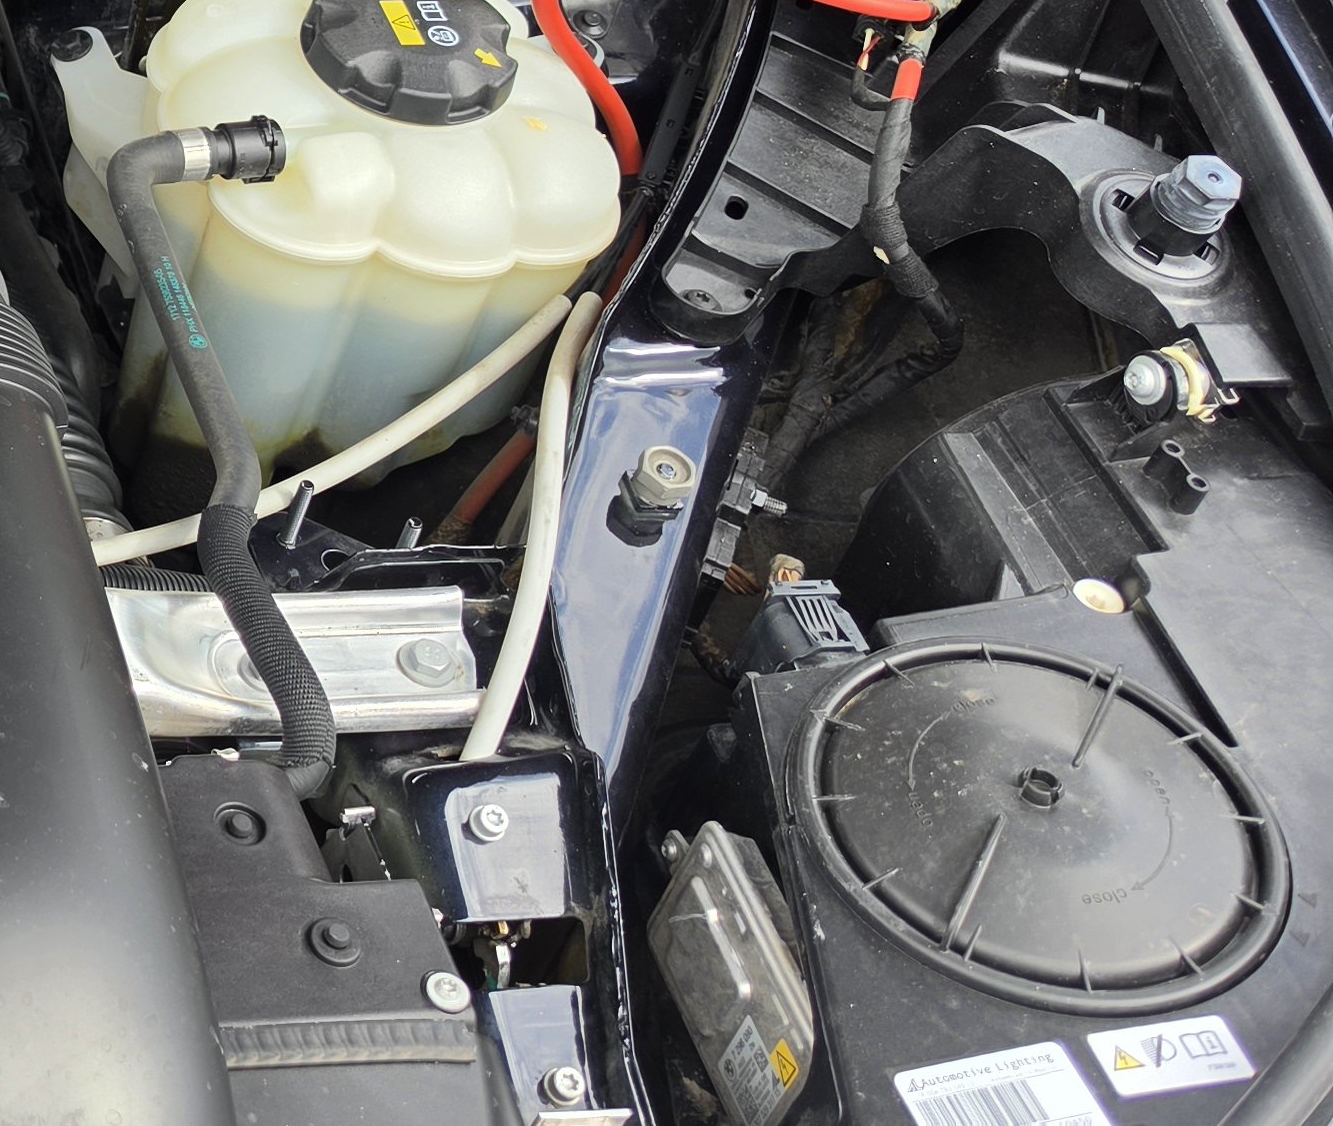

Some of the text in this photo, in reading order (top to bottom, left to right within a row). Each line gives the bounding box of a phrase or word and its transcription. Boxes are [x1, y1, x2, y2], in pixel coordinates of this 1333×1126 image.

[1081, 886, 1128, 906] close
[920, 1066, 992, 1090] Automotive
[996, 1053, 1056, 1072] Lighting
